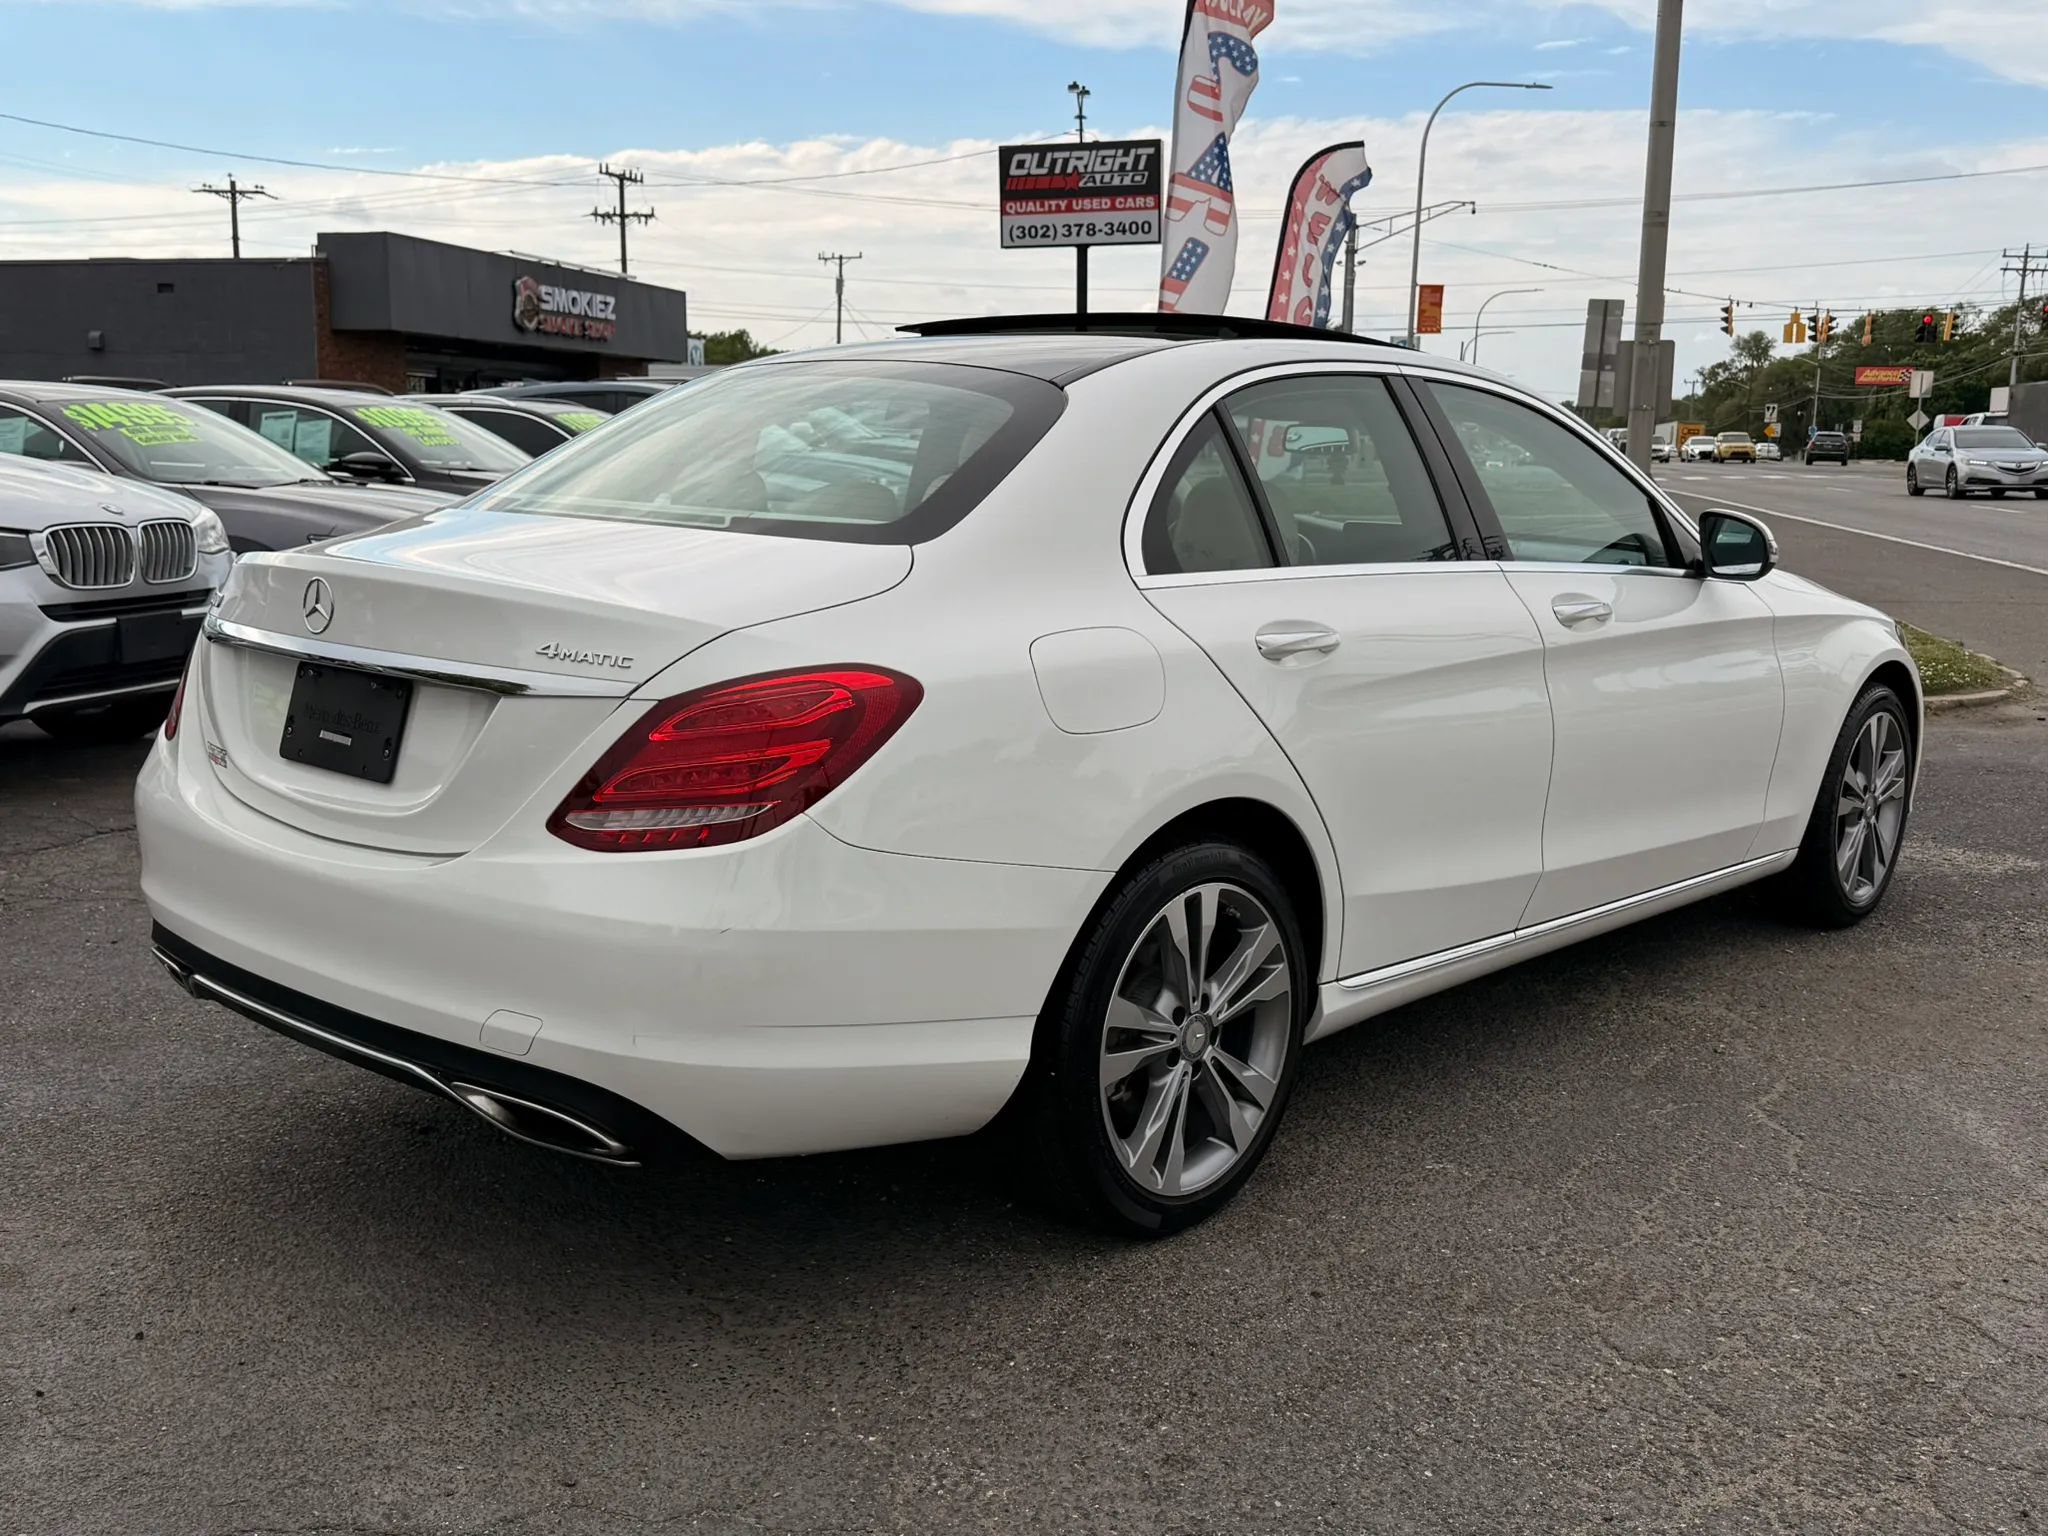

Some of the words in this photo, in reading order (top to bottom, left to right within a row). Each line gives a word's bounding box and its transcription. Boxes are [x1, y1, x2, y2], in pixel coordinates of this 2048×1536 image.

[1009, 147, 1155, 176] OUTRIGHT
[1083, 173, 1147, 187] AUTO
[1005, 200, 1068, 214] QUALITY
[1072, 198, 1110, 210] USED
[1115, 196, 1155, 209] CARS
[1009, 223, 1057, 243] (302)
[1061, 220, 1152, 238] 378-3400
[539, 285, 616, 320] SMOKIEZ
[535, 641, 634, 669] 4MATIC
